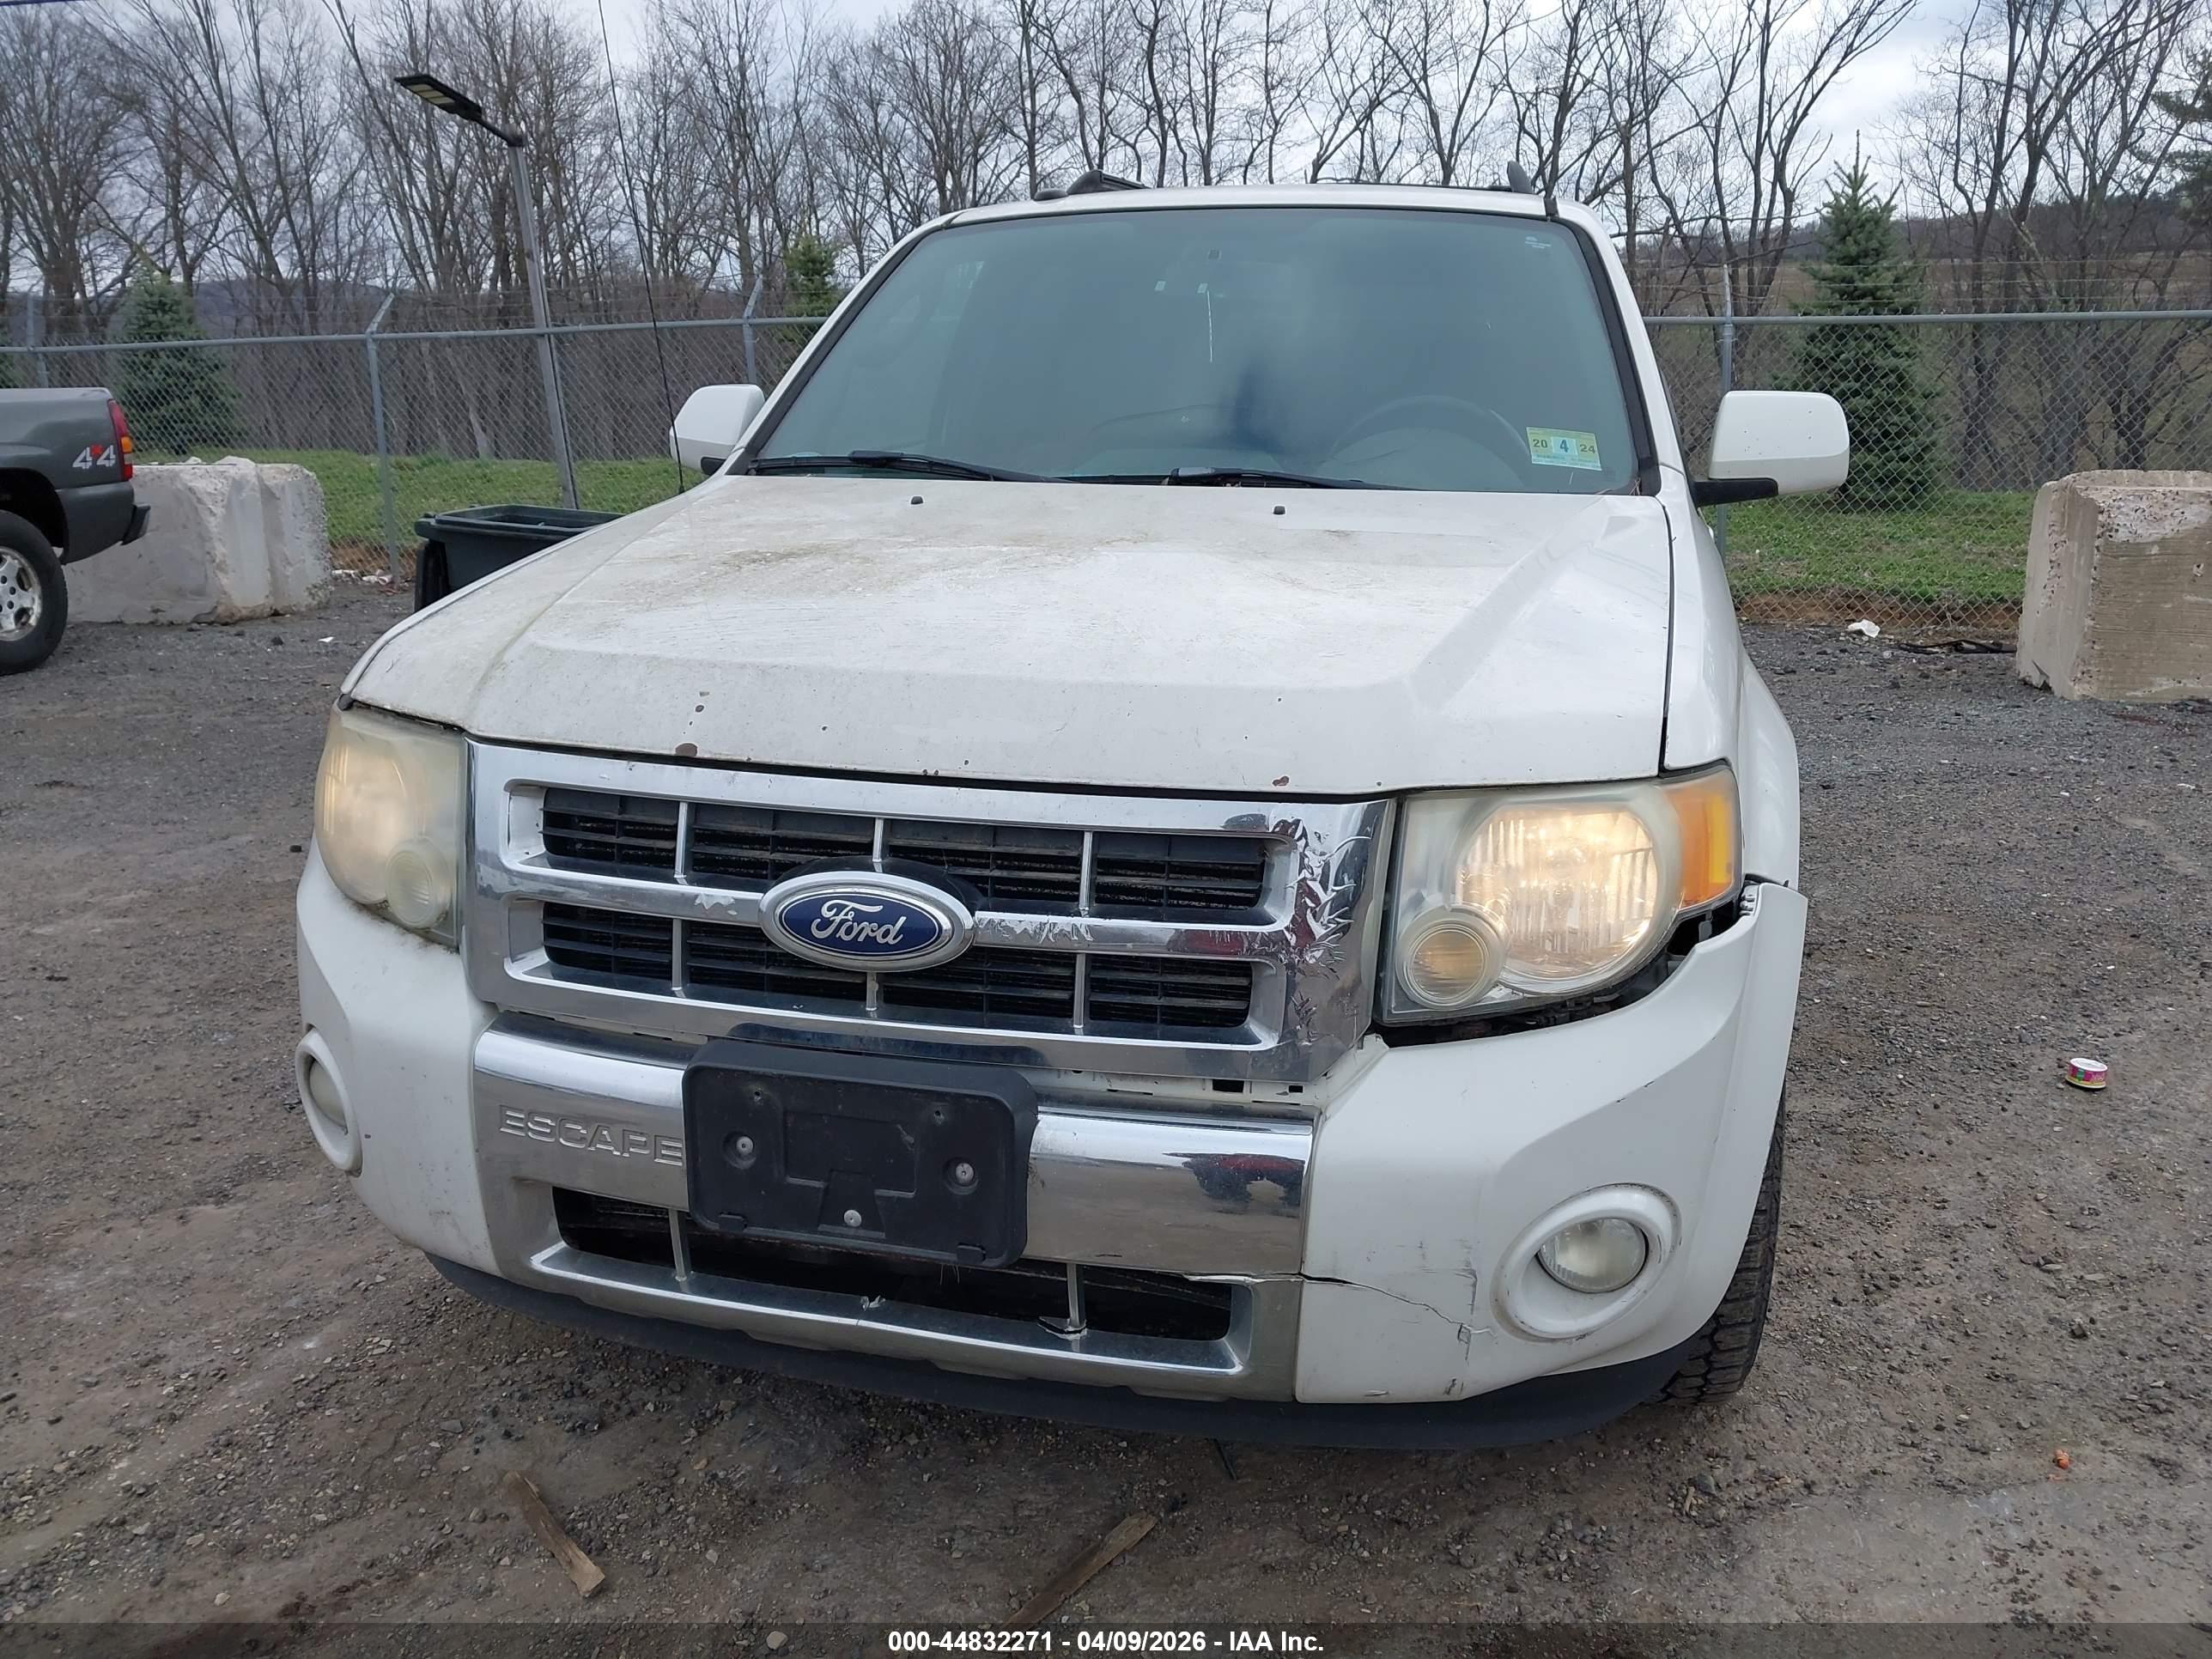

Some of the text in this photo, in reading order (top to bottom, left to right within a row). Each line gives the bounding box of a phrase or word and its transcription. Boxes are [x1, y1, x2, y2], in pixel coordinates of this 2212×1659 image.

[1533, 439, 1595, 453] 20 4 24
[811, 899, 907, 945] Ford
[499, 1104, 684, 1166] ESCAPE
